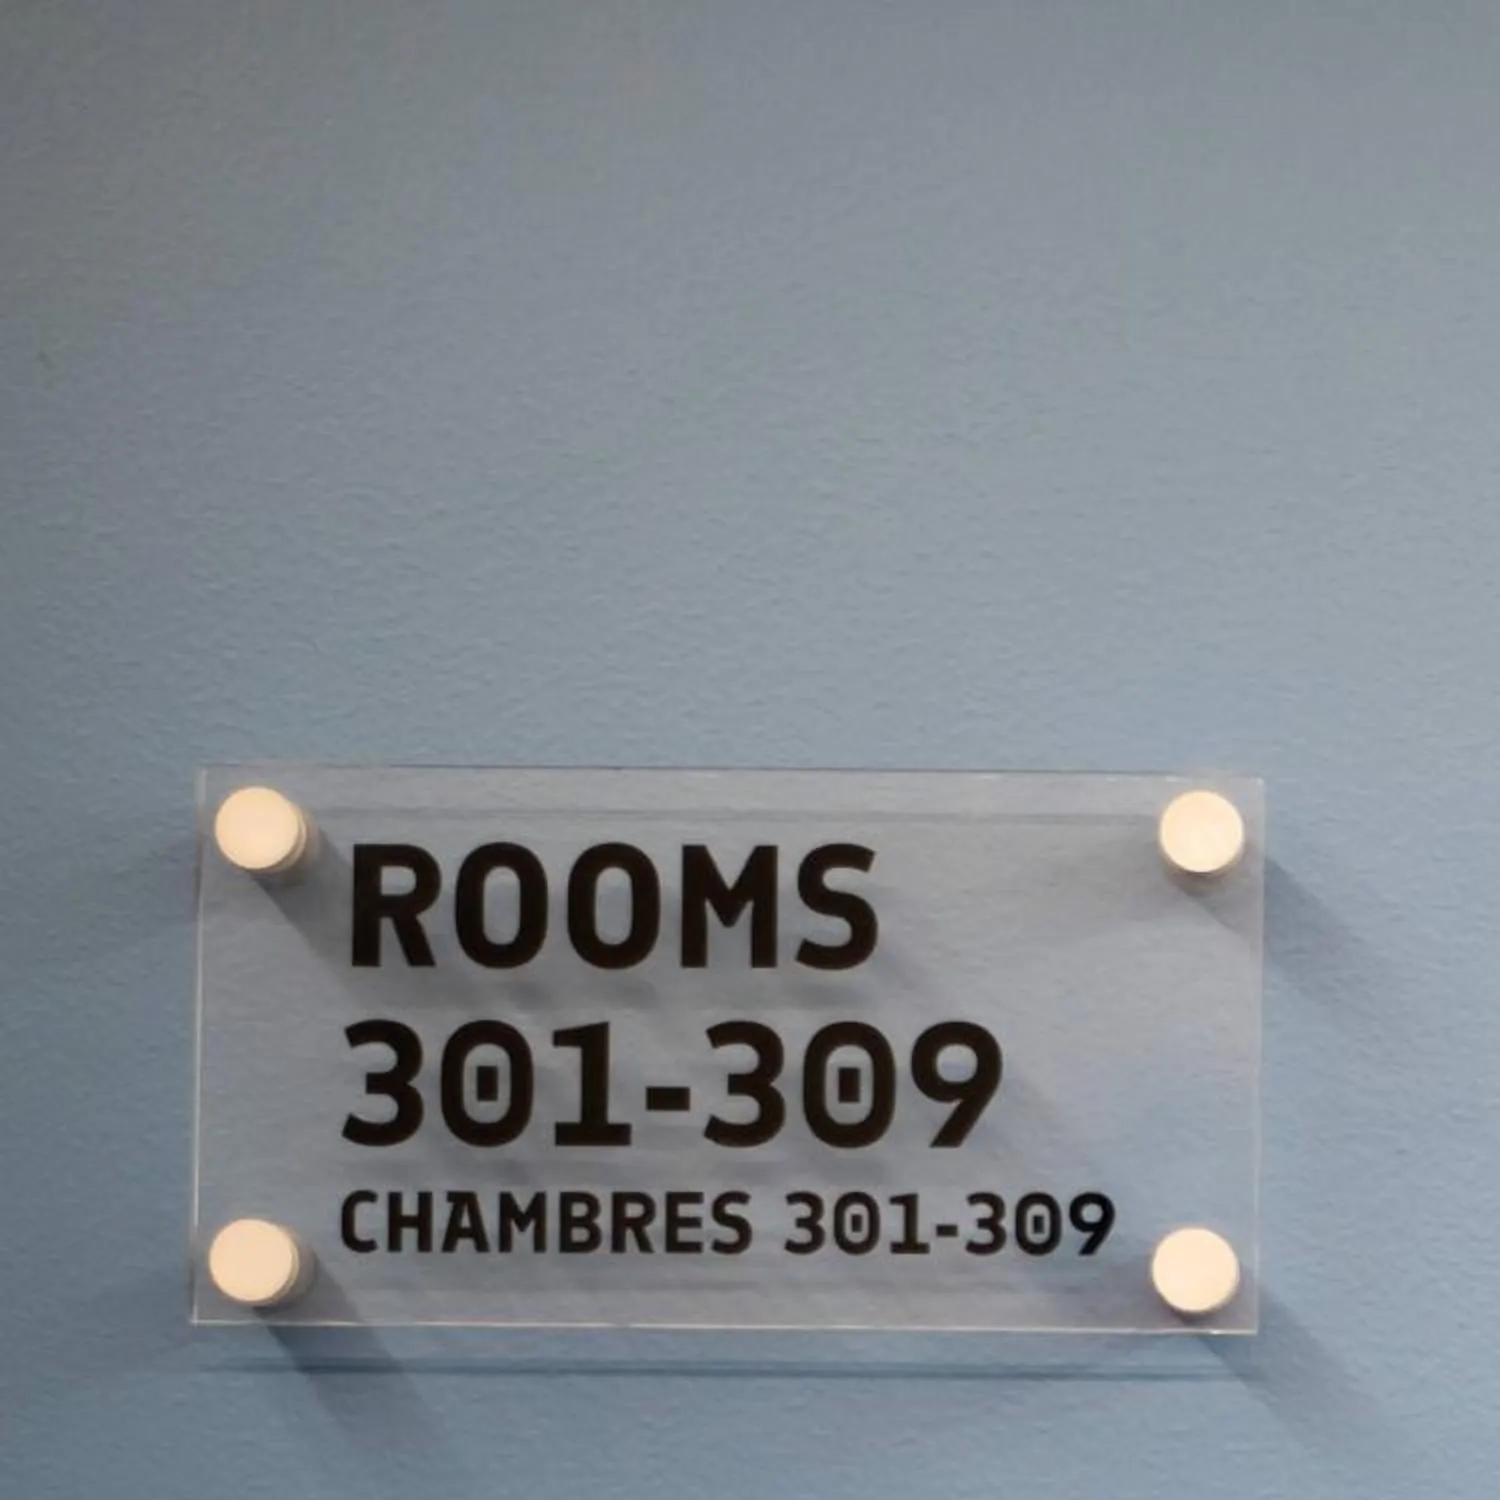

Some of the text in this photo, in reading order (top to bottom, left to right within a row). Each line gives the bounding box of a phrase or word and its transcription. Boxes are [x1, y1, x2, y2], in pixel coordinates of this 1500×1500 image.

[349, 841, 879, 971] ROOMS
[341, 1018, 1004, 1149] 301-309
[340, 1190, 1117, 1257] CHAMBRES 301-309
